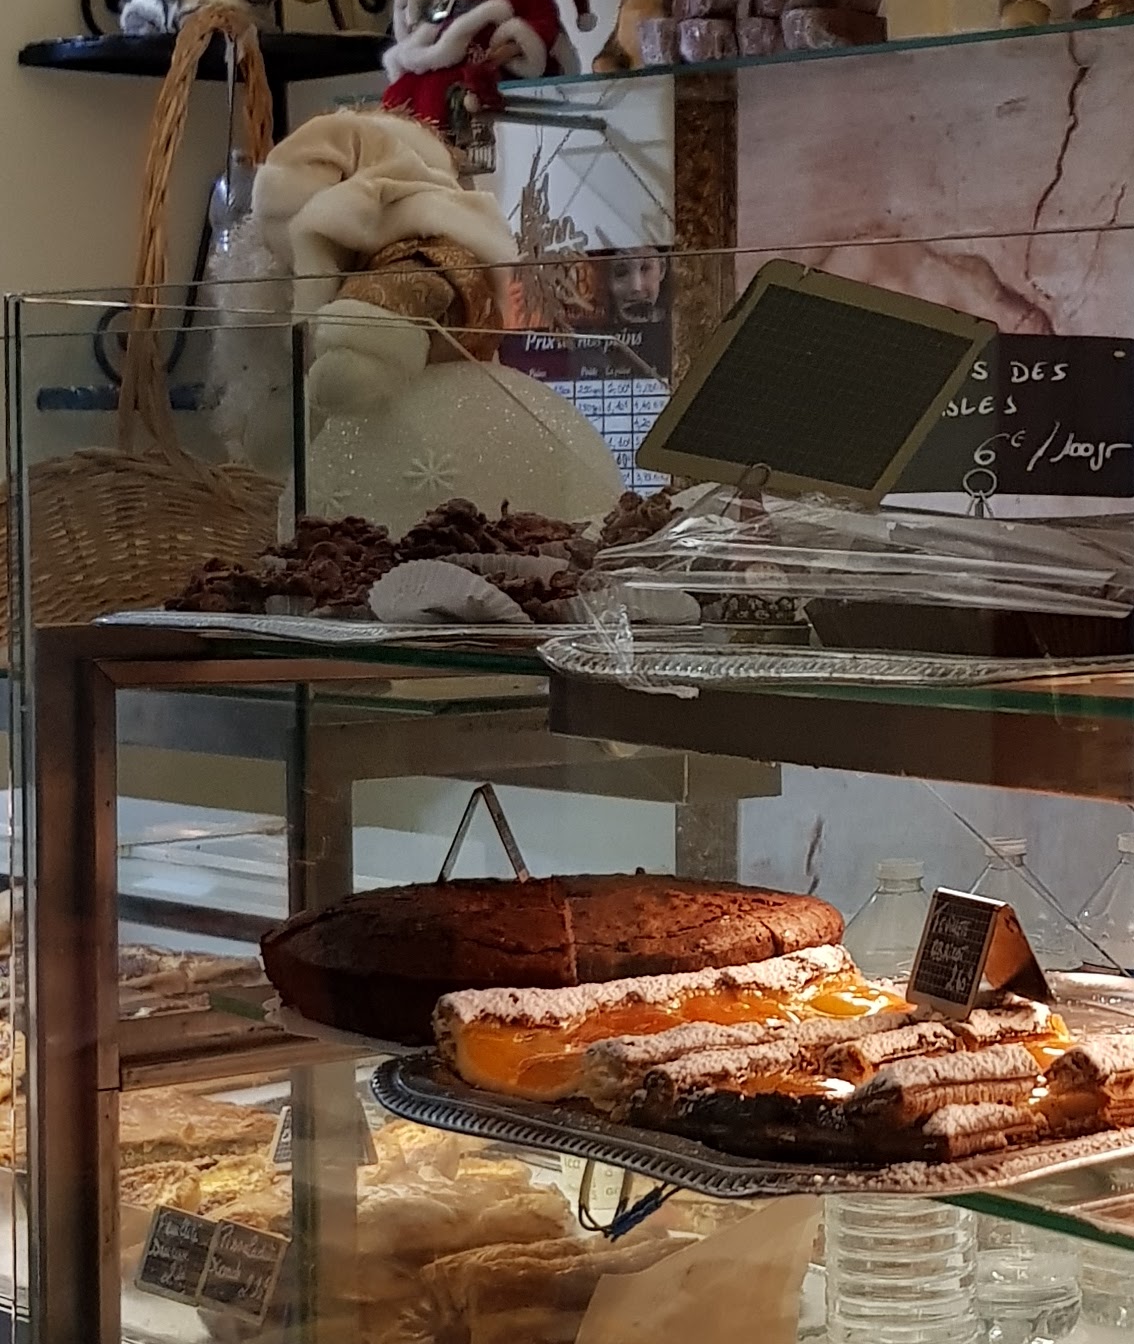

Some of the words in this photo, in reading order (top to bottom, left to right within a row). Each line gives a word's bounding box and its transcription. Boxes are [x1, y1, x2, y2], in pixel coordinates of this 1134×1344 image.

[525, 332, 555, 351] Prix
[604, 328, 642, 353] pains
[1010, 361, 1069, 384] DES
